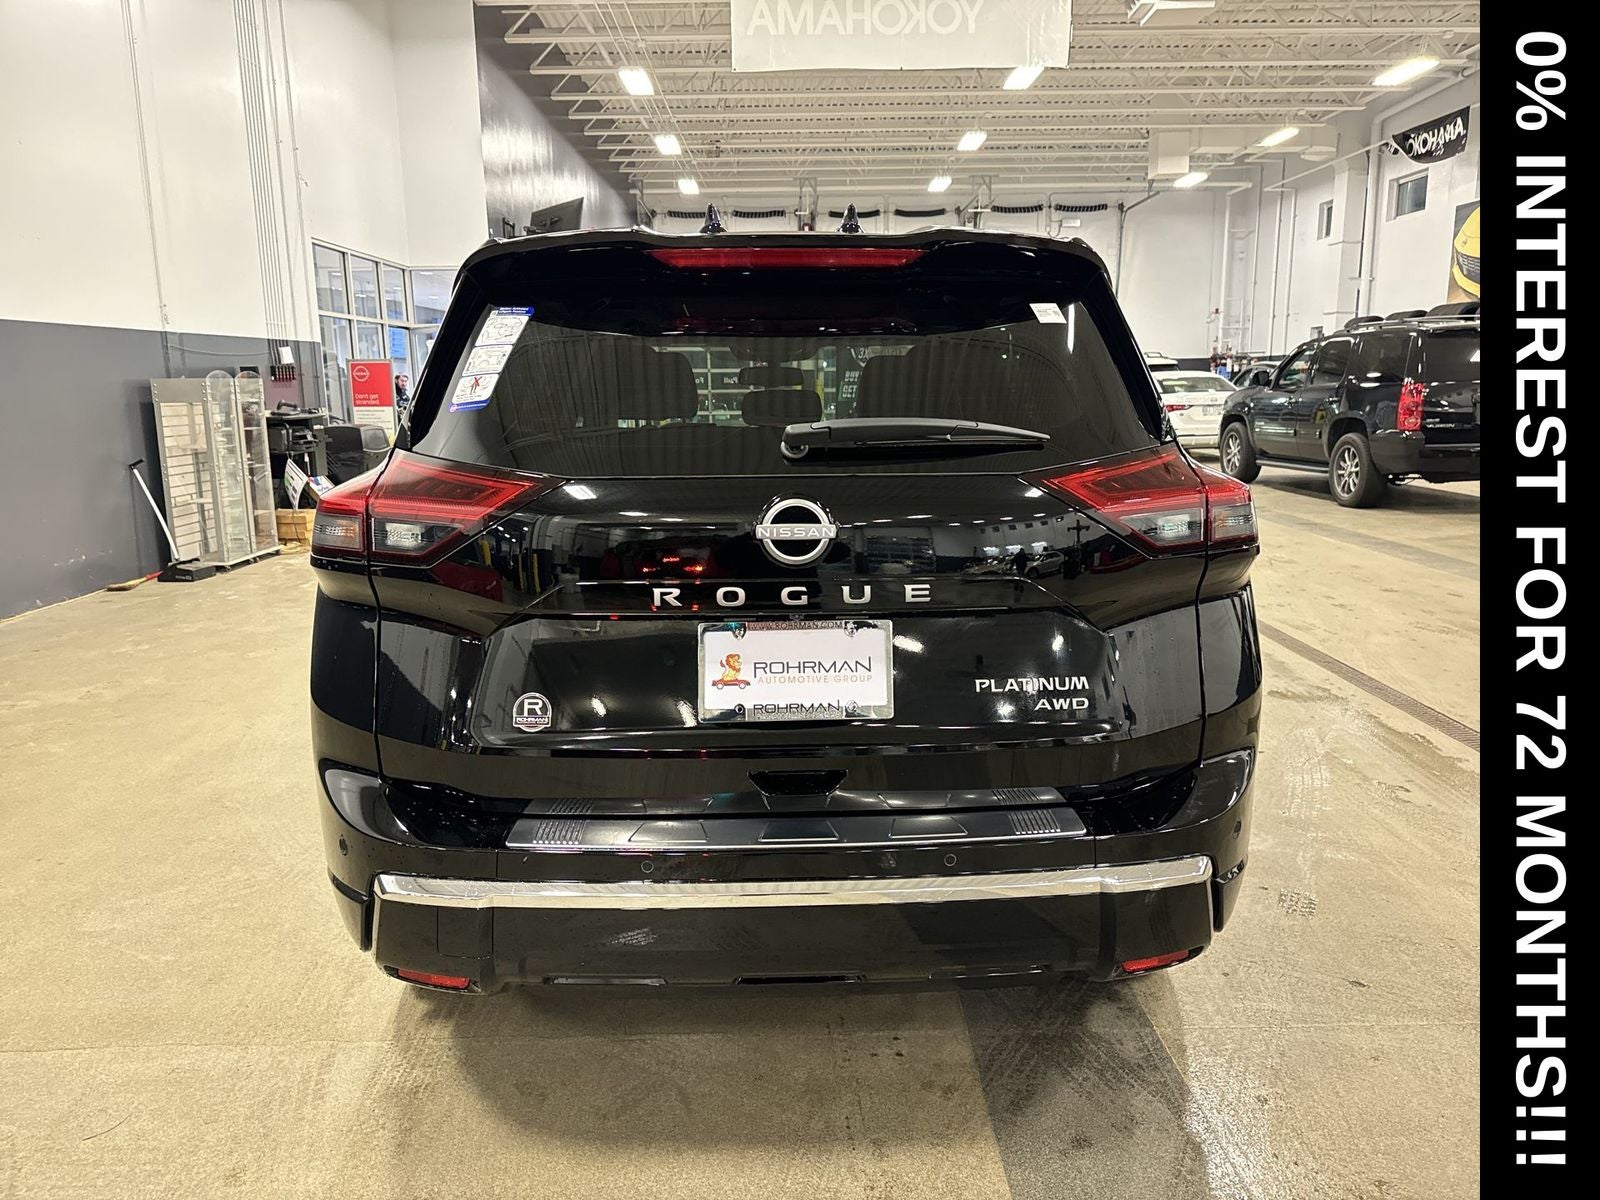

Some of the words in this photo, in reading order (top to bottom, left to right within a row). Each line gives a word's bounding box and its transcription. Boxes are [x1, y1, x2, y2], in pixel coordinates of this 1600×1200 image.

[757, 526, 836, 538] NISSAN
[652, 584, 932, 607] ROGUE
[750, 621, 843, 631] WWW.ROHRMAN.COM
[753, 656, 872, 678] ROHRMAN
[758, 675, 829, 685] AUTOMOTIVE
[834, 674, 873, 683] GROUP
[974, 676, 1090, 693] PLATINUM
[524, 698, 543, 716] R
[753, 699, 840, 716] ROHRMAN
[1034, 697, 1090, 711] AWD
